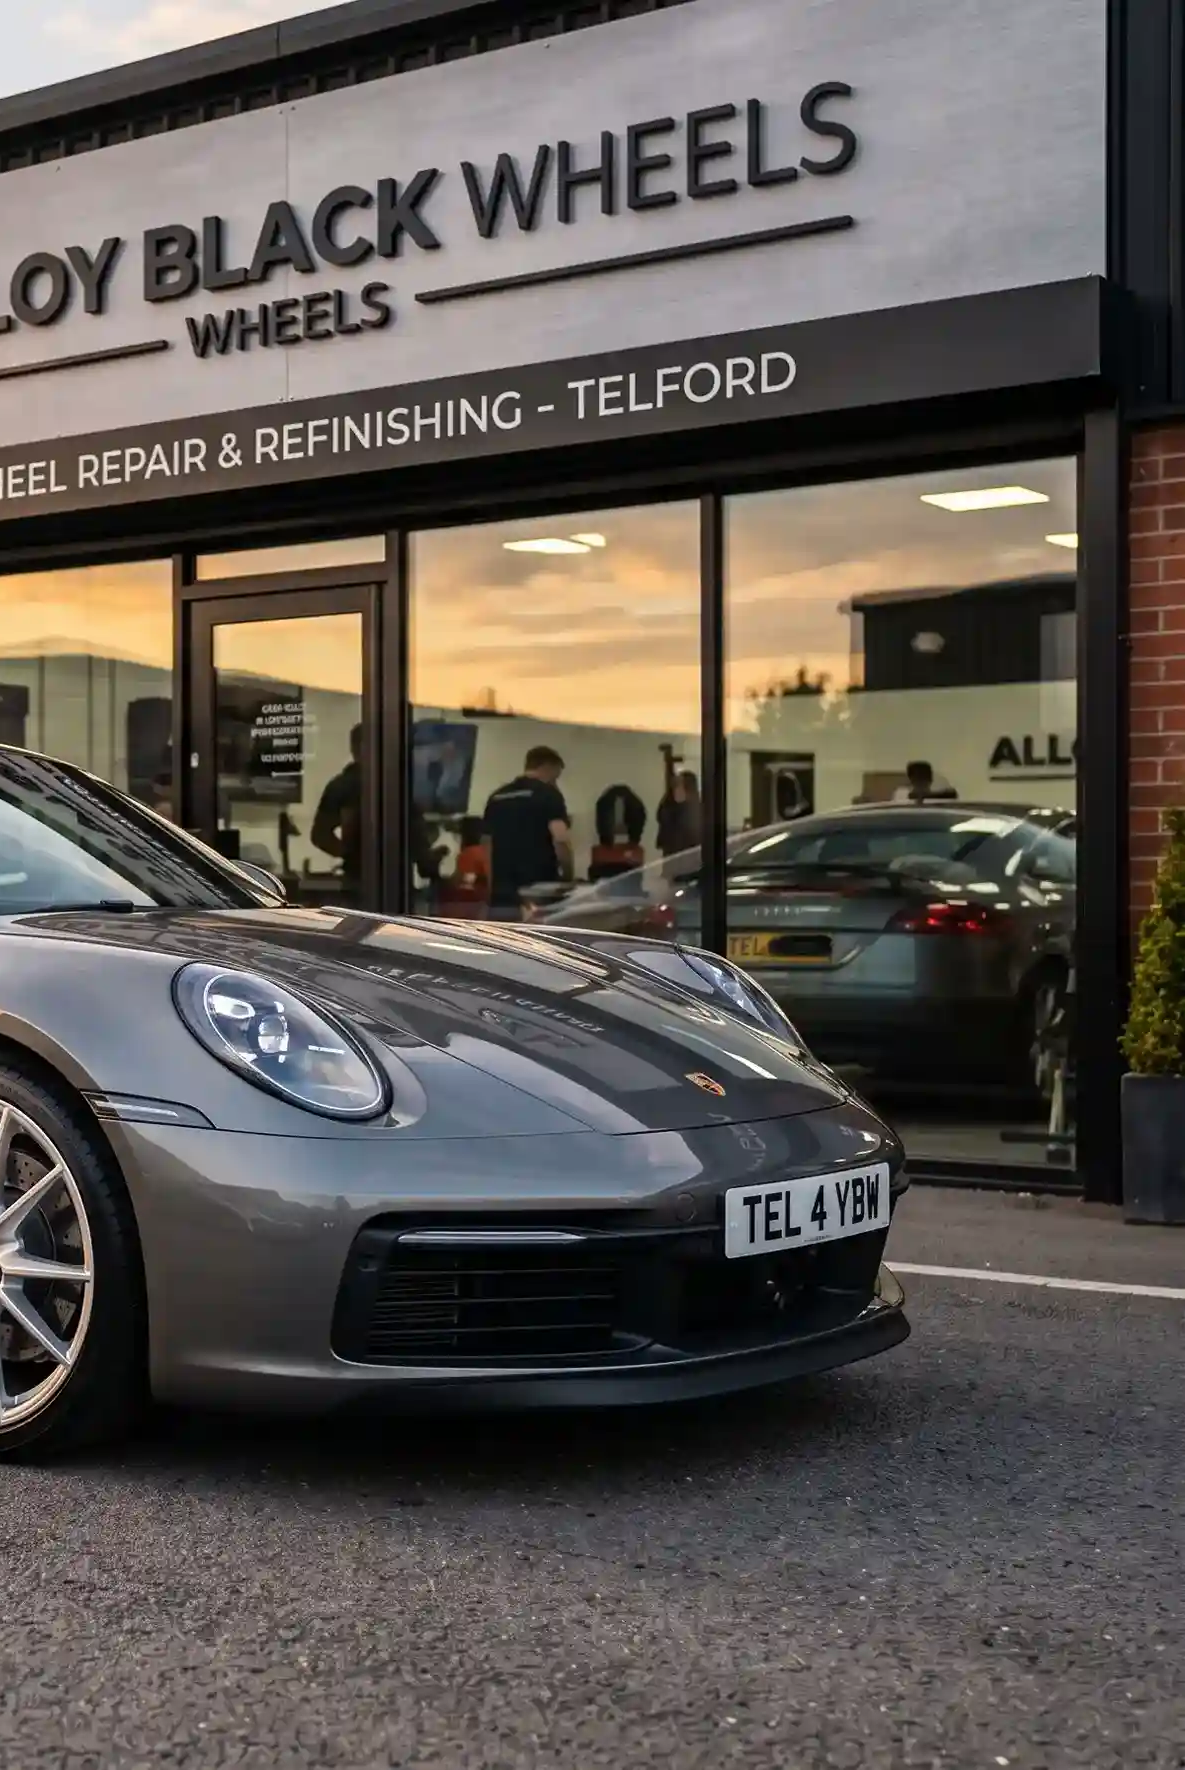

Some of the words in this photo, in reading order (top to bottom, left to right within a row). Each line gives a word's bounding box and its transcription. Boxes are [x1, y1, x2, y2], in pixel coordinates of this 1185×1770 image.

[143, 168, 441, 302] BLACK
[460, 81, 857, 239] WHEELS
[185, 281, 392, 358] WHEELS
[78, 438, 207, 489] REPAIR
[218, 433, 243, 469] &
[255, 391, 522, 464] REFINISHING
[567, 352, 796, 419] TELFORD
[989, 734, 1077, 768] ALL
[743, 1191, 801, 1243] TEL
[811, 1185, 827, 1231] 4
[835, 1173, 880, 1226] YBW
